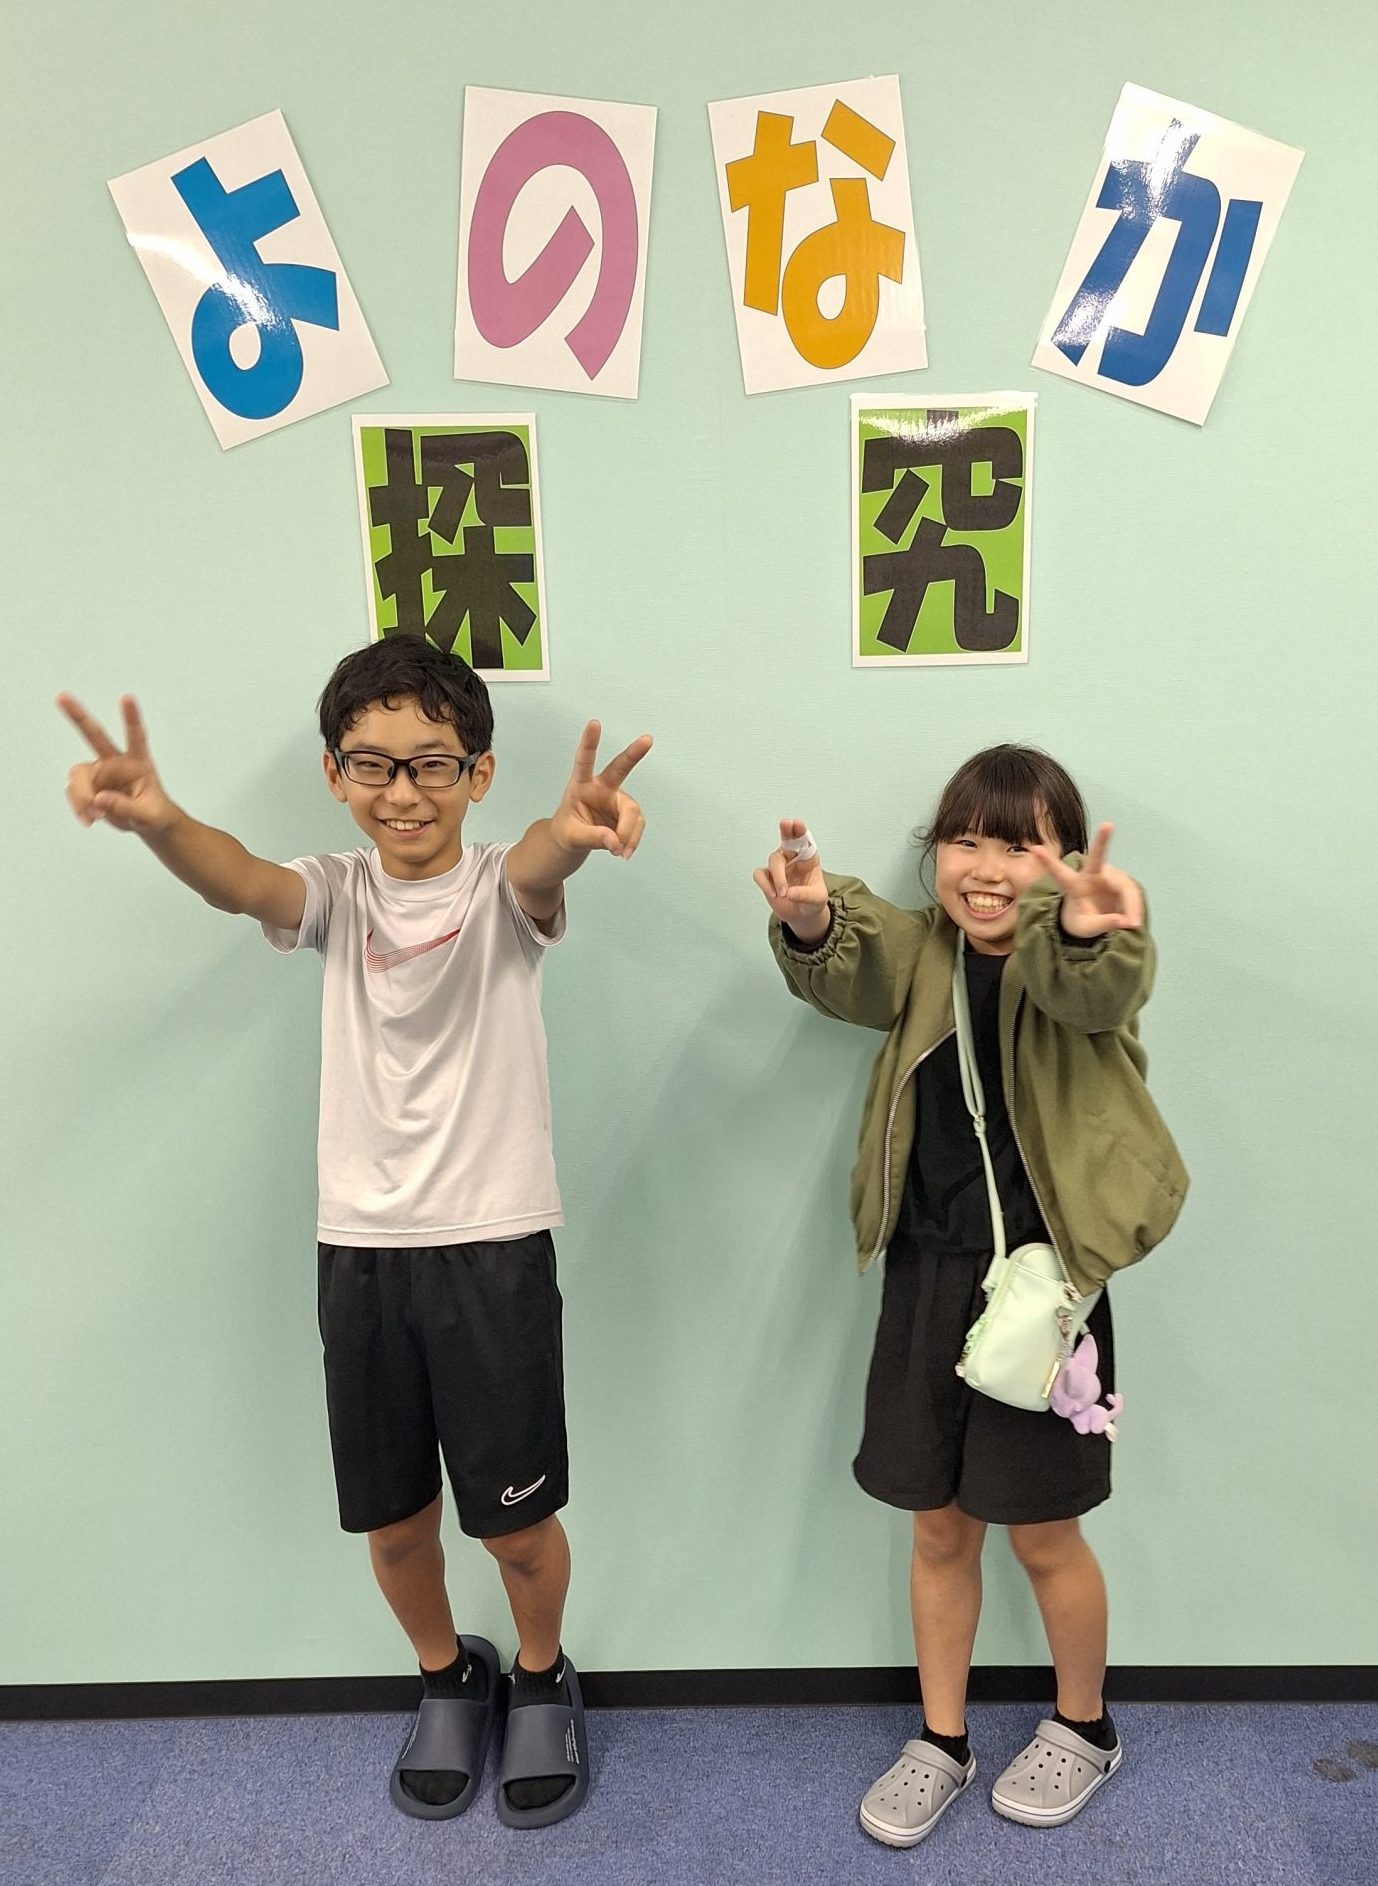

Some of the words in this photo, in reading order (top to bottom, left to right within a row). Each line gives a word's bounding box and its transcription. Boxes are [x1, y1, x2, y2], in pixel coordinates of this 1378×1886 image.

[171, 157, 339, 420] よ
[469, 111, 638, 381] の
[726, 100, 905, 368] な
[1052, 118, 1263, 386] か
[369, 428, 537, 670] 探
[862, 410, 1023, 652] 究
